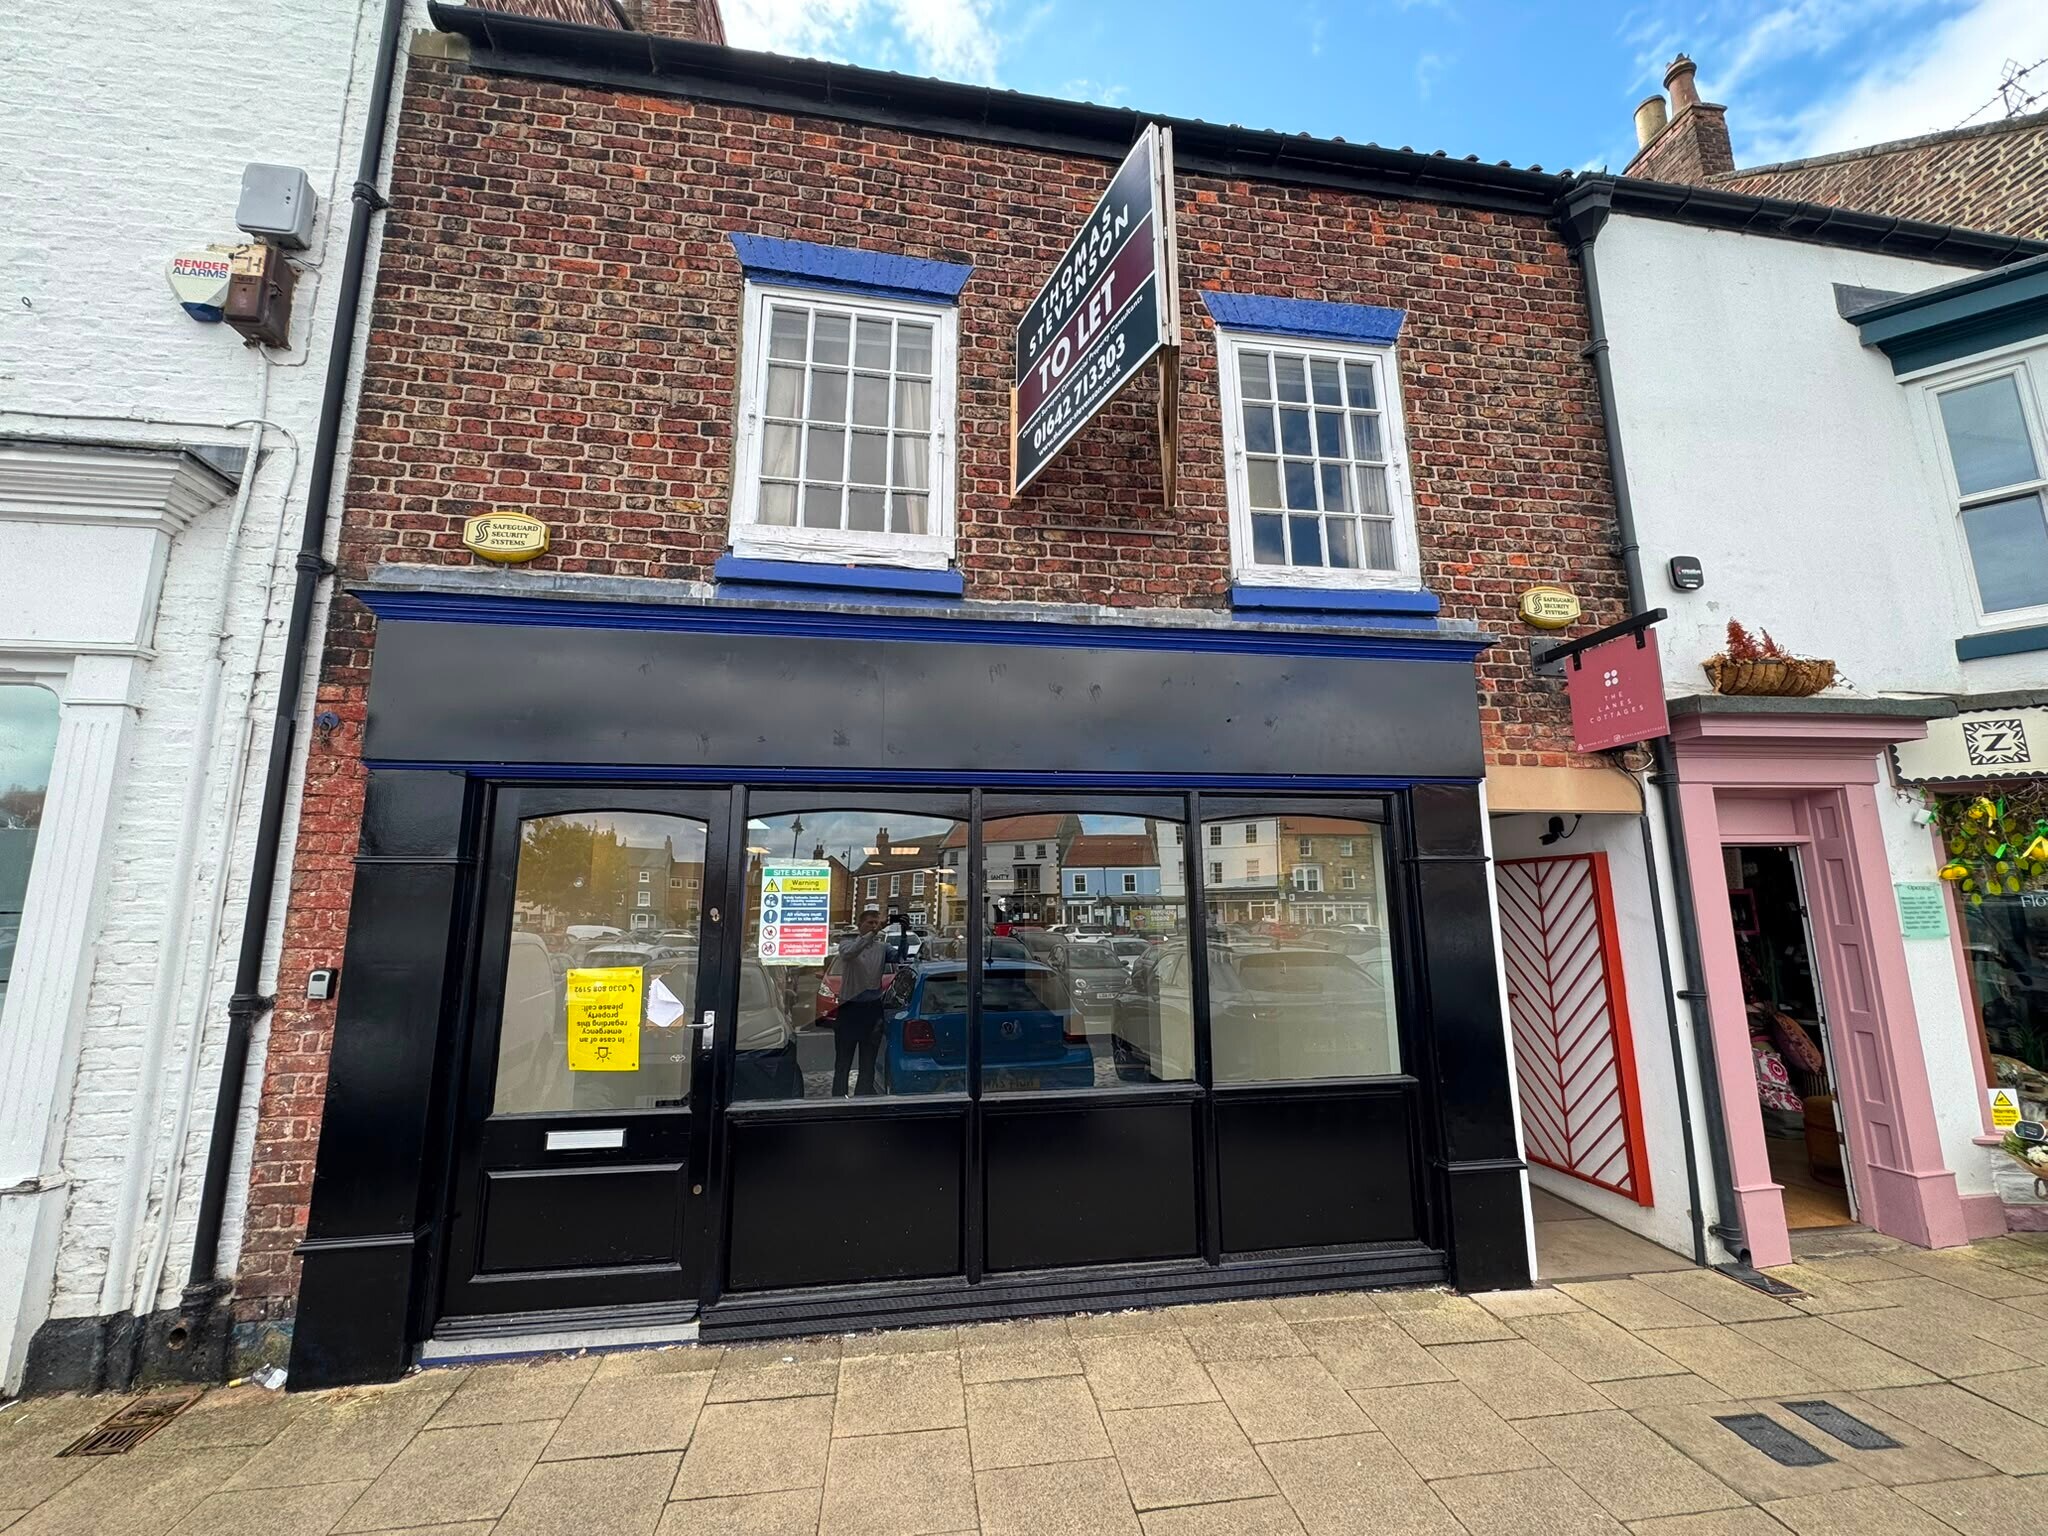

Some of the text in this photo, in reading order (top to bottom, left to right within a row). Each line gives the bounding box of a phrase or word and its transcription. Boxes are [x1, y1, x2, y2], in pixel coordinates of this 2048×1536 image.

[174, 258, 229, 271] RENDER
[1041, 203, 1112, 317] THOMAS
[172, 267, 227, 279] ALARMS
[1029, 203, 1129, 357] STEVENSON
[1038, 270, 1116, 394] TO LET
[1061, 358, 1089, 393] Commercial
[1088, 332, 1110, 362] Property
[1110, 294, 1143, 334] Consultants
[1033, 333, 1126, 450] 01642 713303
[491, 531, 529, 539] SECURITY
[492, 523, 539, 532] SAFEGUARD
[1604, 691, 1623, 701] THE
[1598, 698, 1632, 713] LANES
[1589, 704, 1644, 724] COTTAGES
[1981, 733, 2012, 752] Z
[791, 879, 820, 887] Warning
[2020, 894, 2048, 908] Flo
